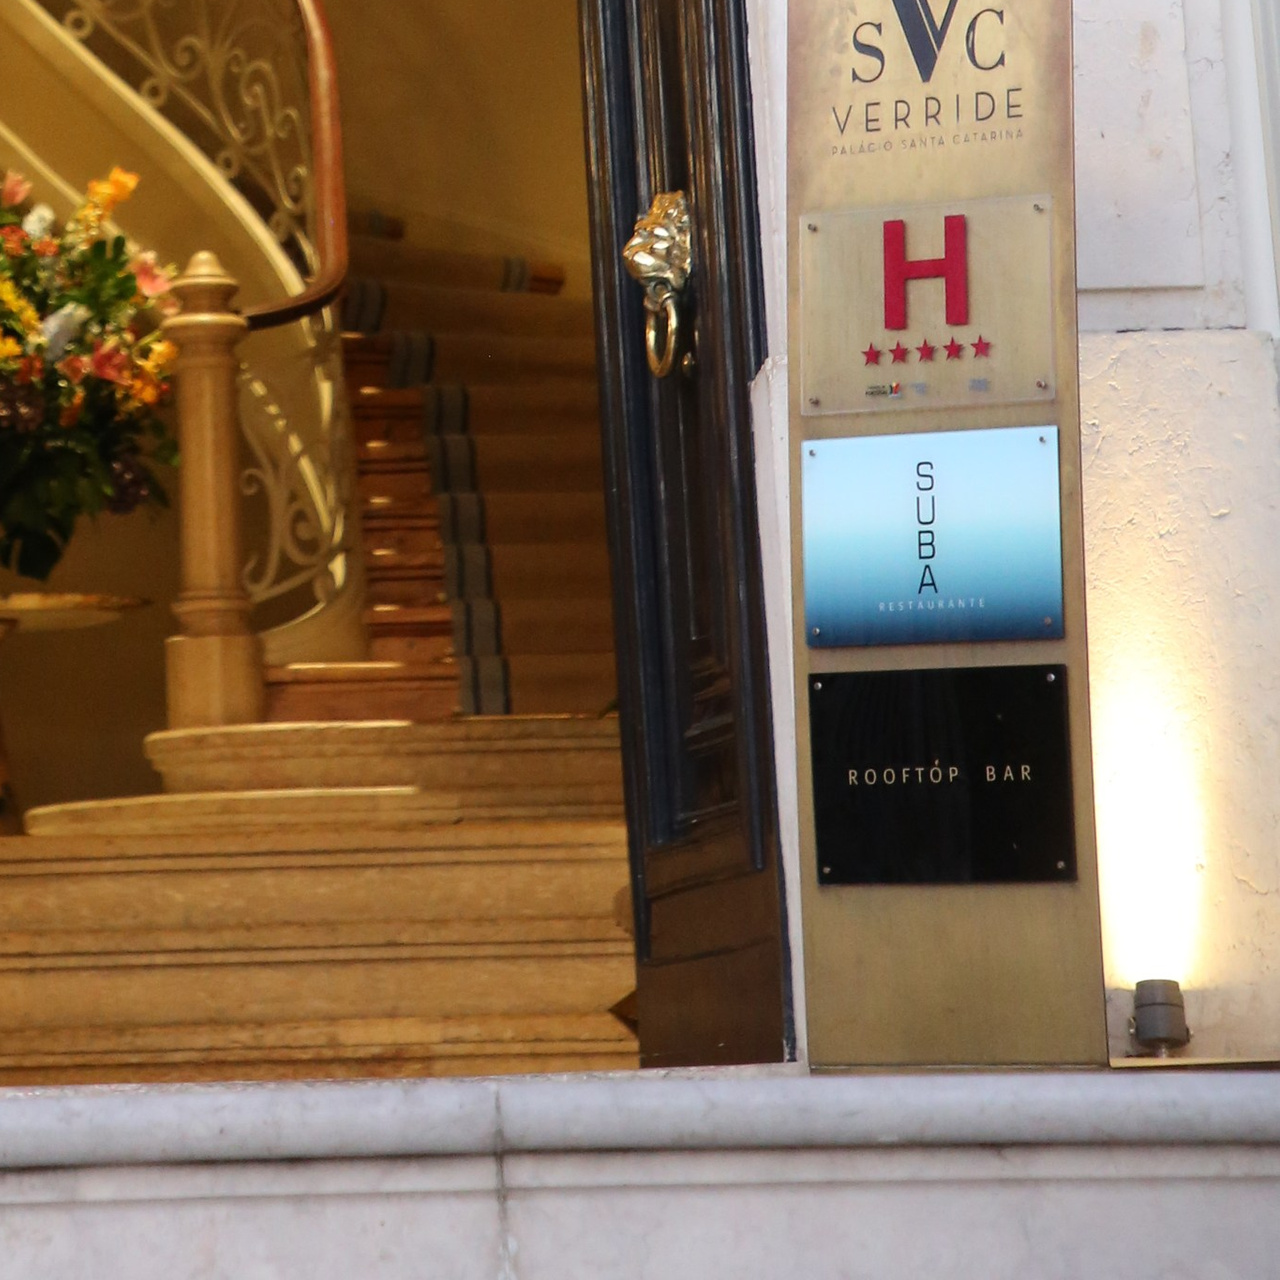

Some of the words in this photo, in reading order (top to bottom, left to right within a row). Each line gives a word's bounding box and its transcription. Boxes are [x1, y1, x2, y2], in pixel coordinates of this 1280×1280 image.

[832, 88, 1023, 136] VERRIDE
[901, 136, 945, 150] SANTA
[952, 128, 1024, 145] CATARINA
[883, 213, 970, 331] H
[916, 461, 938, 595] SUBA
[878, 598, 986, 612] RESTAURANTE
[986, 764, 1031, 782] BAR
